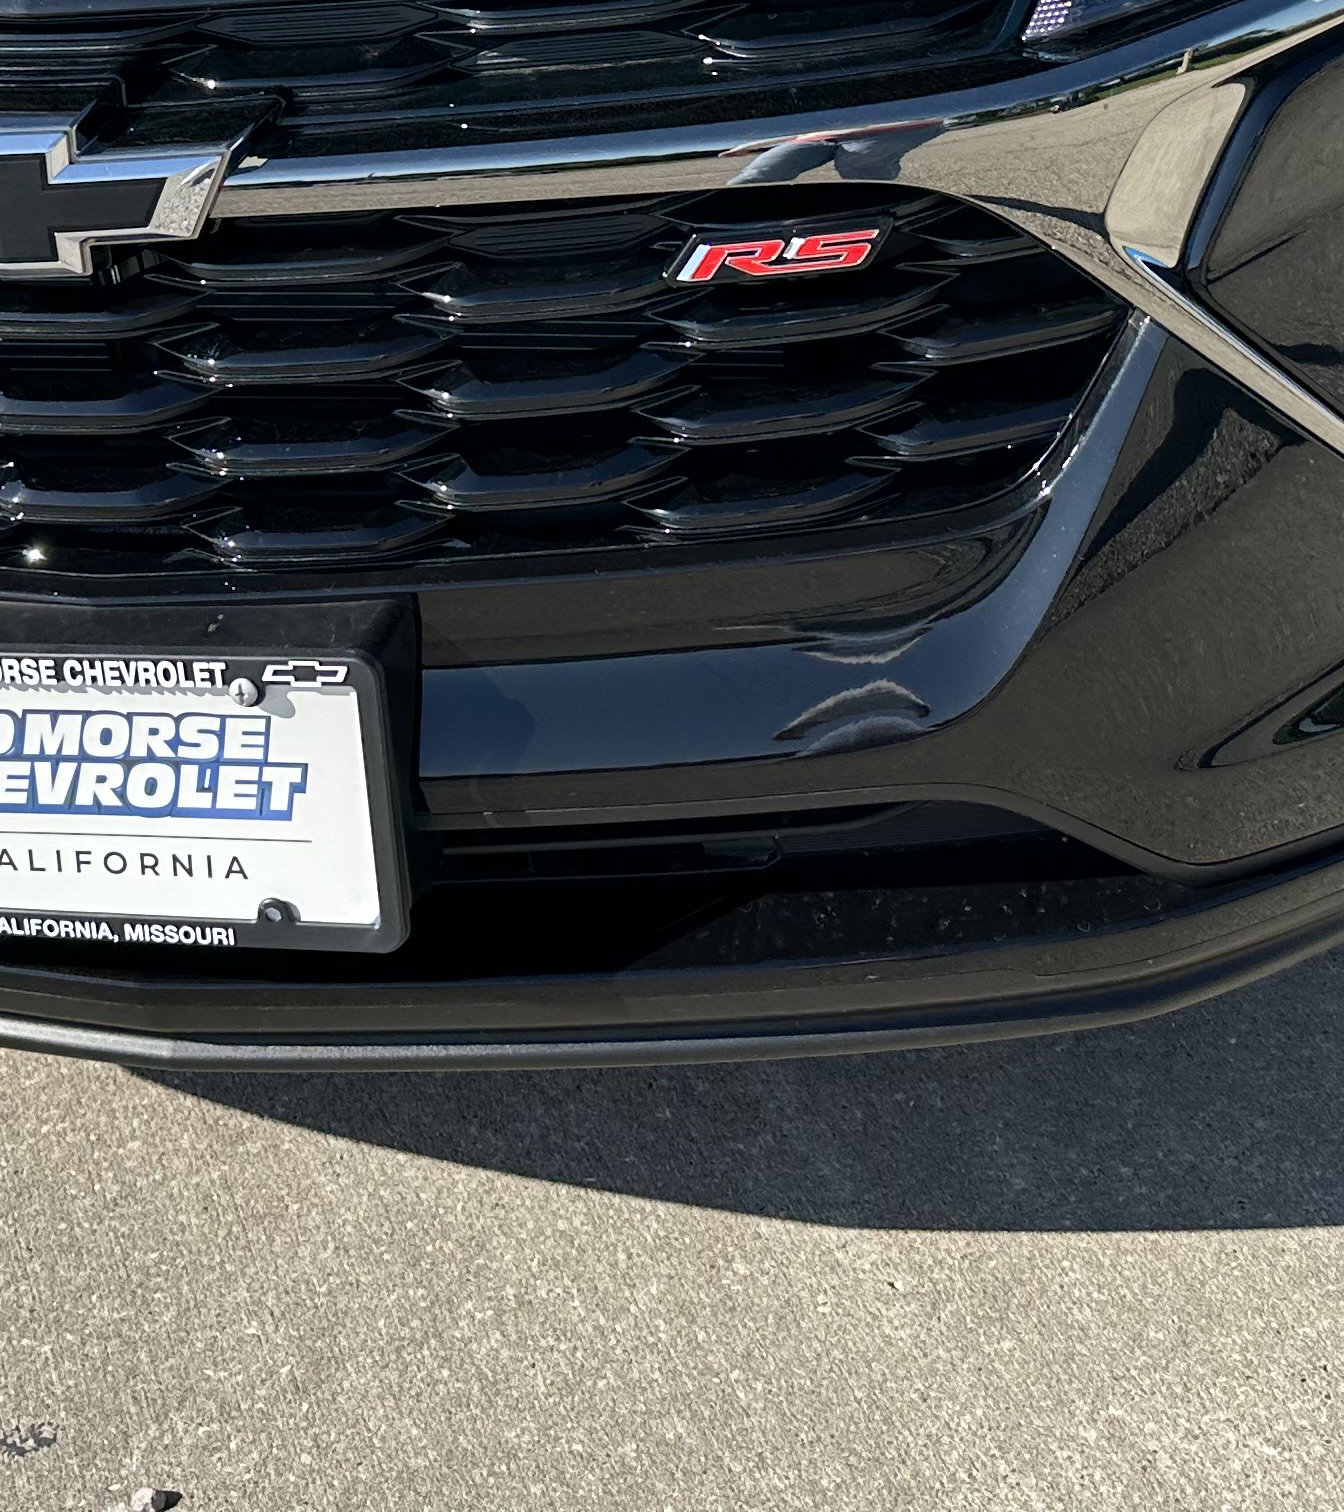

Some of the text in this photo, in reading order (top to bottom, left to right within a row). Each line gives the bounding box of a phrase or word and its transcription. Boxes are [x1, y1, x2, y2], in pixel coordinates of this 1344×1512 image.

[676, 229, 879, 282] RS
[62, 659, 226, 688] CHEVROLET
[22, 709, 271, 763] MORSE
[123, 922, 236, 947] MISSOURI
